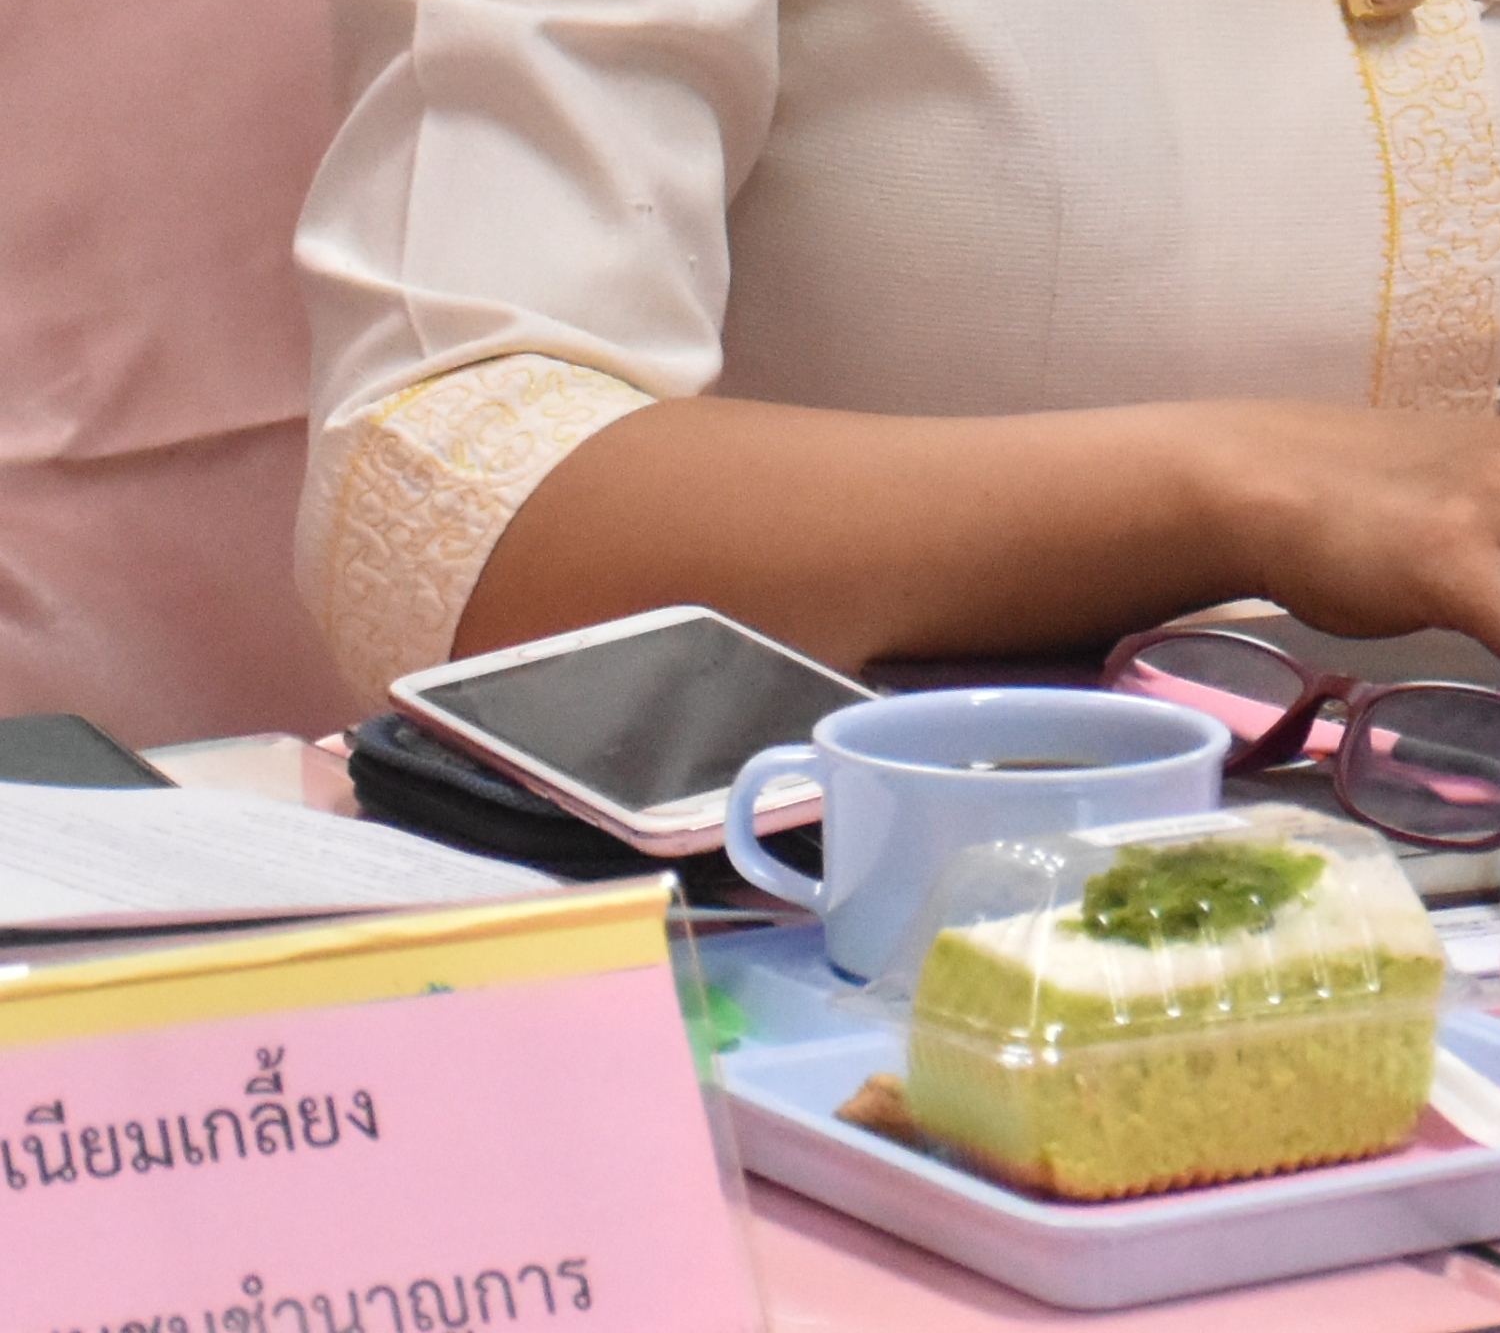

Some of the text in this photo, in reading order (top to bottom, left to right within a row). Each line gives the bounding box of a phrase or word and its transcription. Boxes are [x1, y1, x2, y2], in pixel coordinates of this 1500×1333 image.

[0, 1045, 380, 1190] เนียมเกลี้ยง
[50, 1257, 592, 1333] ชำนาญการ
